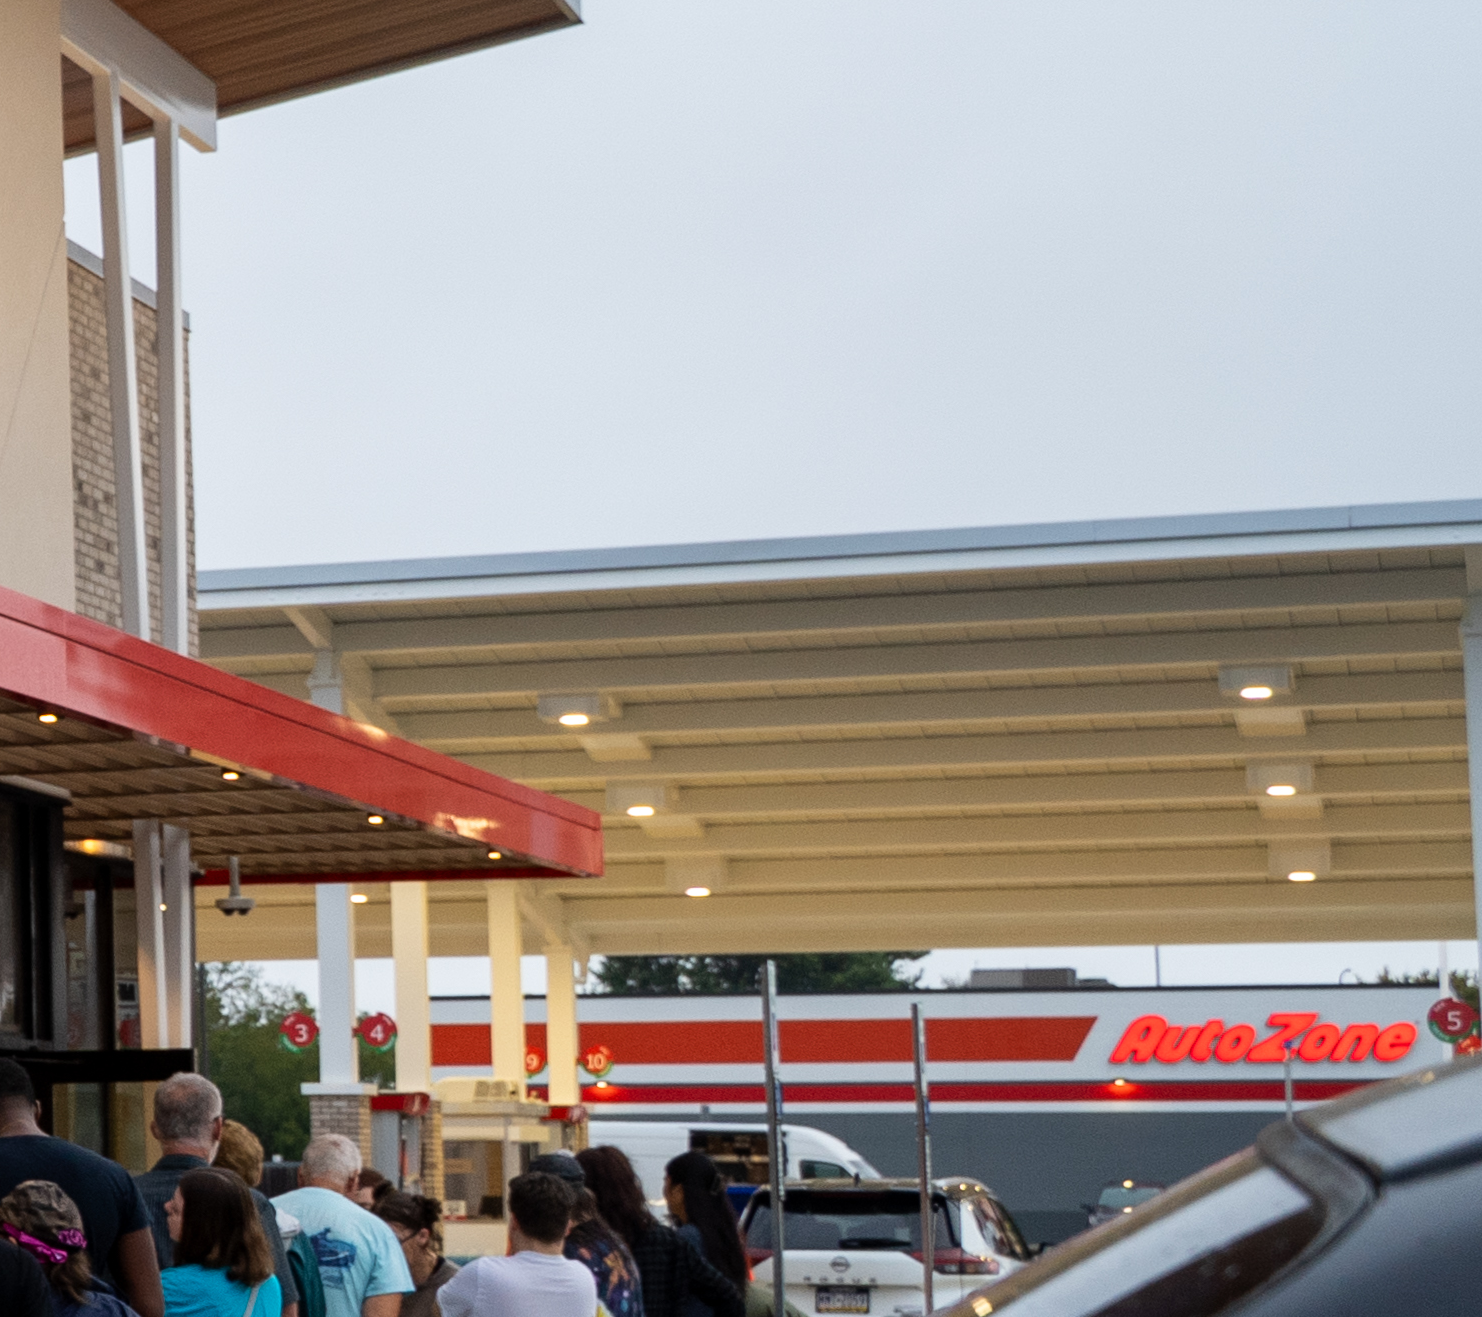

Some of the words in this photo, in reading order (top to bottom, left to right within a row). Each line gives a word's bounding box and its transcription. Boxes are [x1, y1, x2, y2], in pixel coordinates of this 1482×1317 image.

[1447, 1010, 1461, 1031] 5
[294, 1024, 309, 1042] 3
[370, 1024, 384, 1042] 4
[1108, 1011, 1417, 1064] AutoZone
[526, 1053, 539, 1070] 9
[586, 1053, 606, 1070] 10
